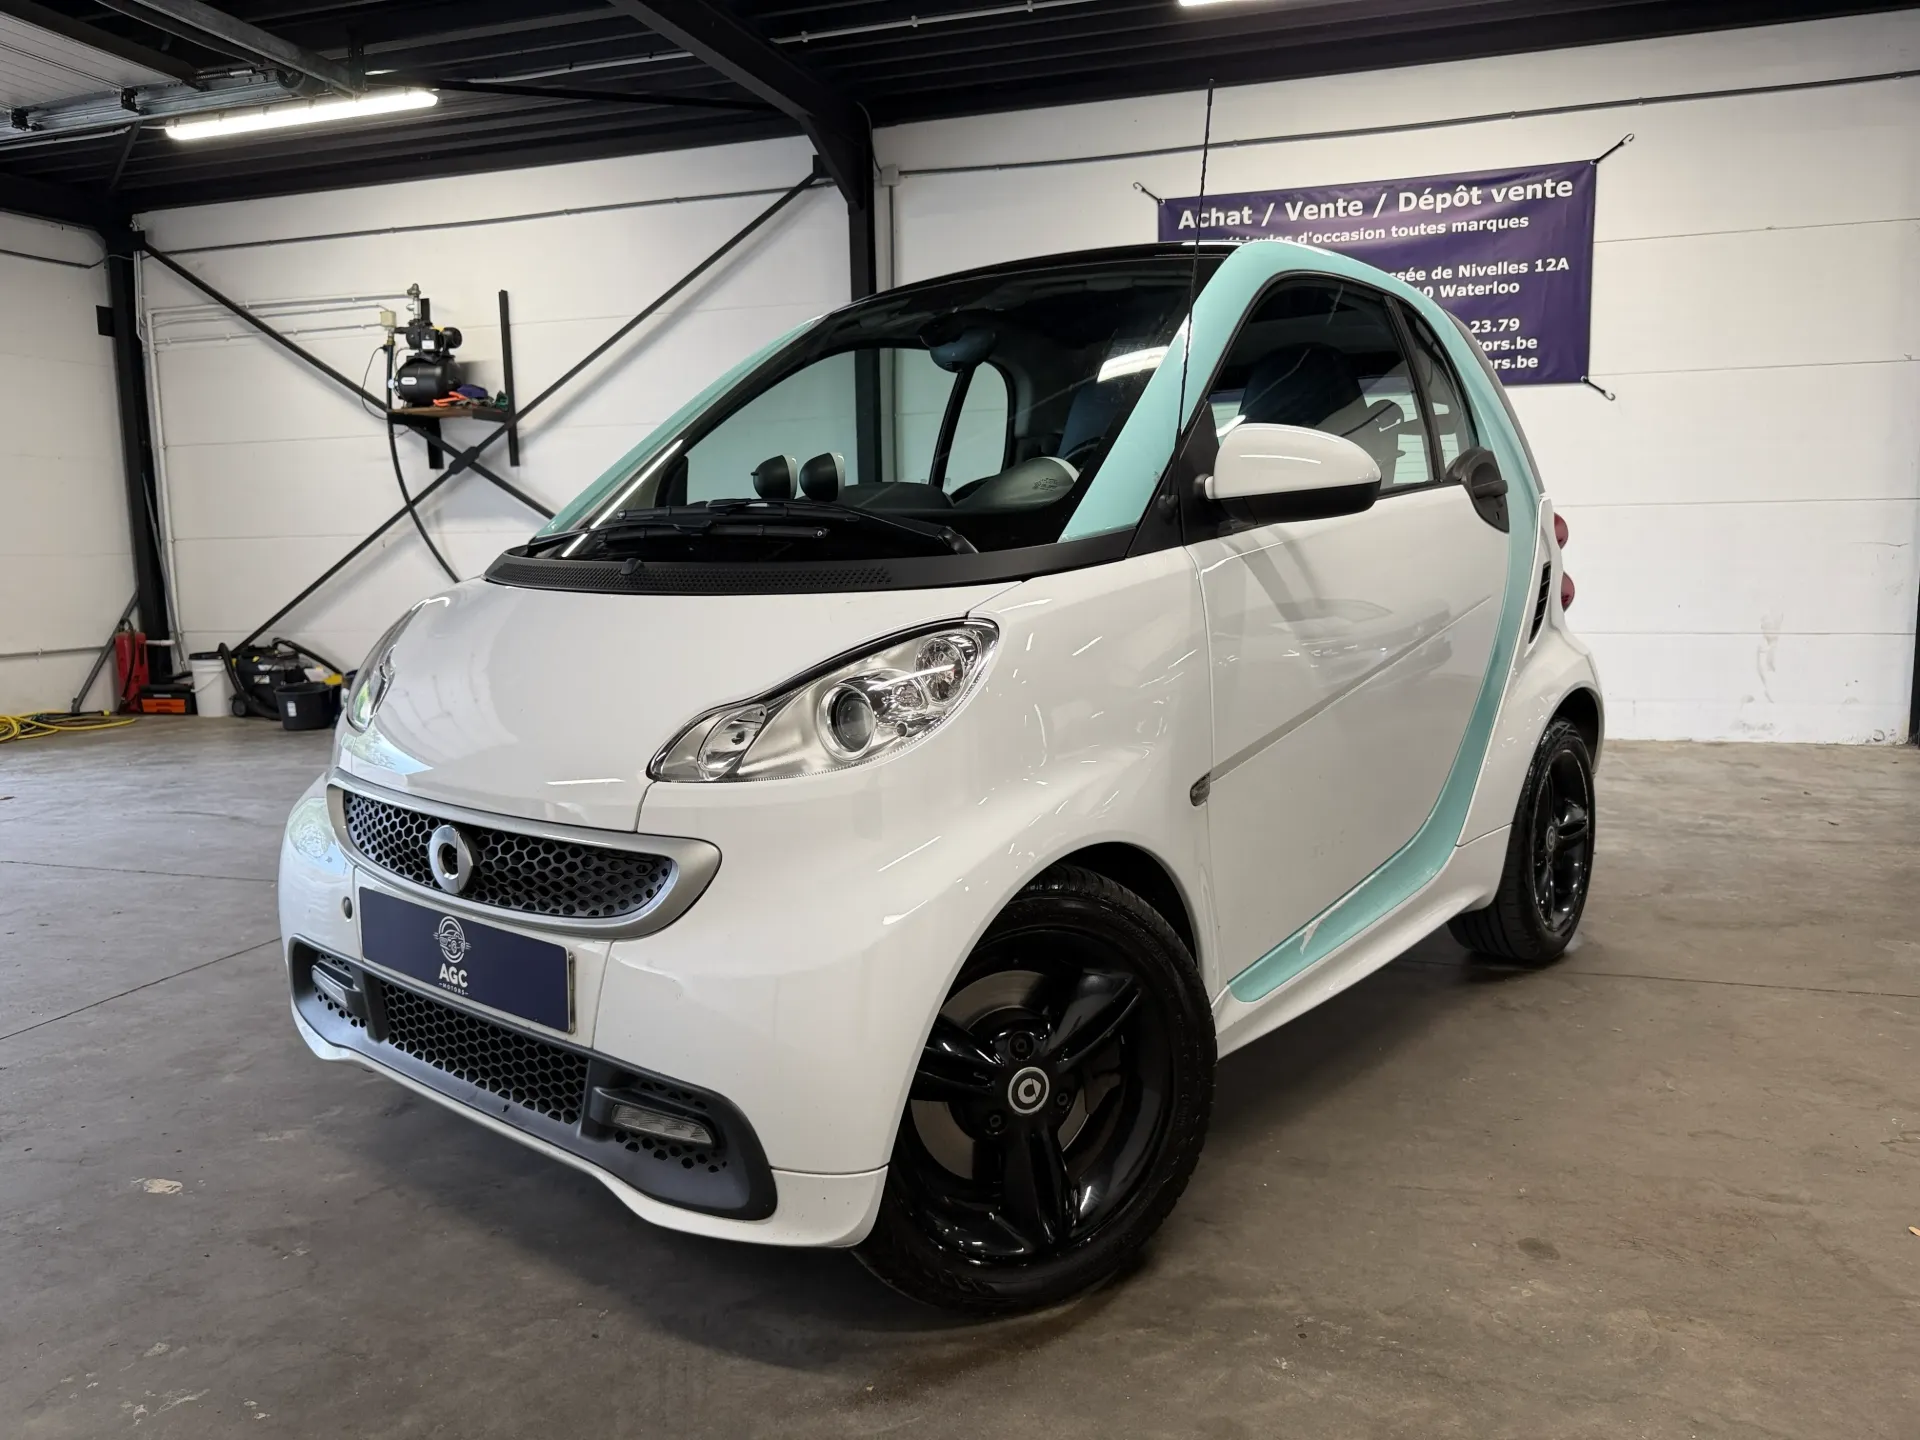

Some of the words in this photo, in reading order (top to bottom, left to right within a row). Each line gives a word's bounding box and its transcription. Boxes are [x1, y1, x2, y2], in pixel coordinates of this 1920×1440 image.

[1178, 206, 1252, 229] Achat
[1261, 203, 1275, 227] /
[1285, 198, 1363, 221] Vente
[1372, 193, 1387, 218] /
[1398, 185, 1482, 214] Dépôt
[1491, 178, 1573, 202] vente
[1297, 227, 1386, 244] d'occasion
[1391, 222, 1447, 238] toutes
[1451, 216, 1530, 233] marques
[1431, 265, 1453, 280] de
[1458, 261, 1529, 278] Nivelles
[1534, 257, 1570, 273] 12A
[1439, 281, 1520, 298] Waterloo
[1470, 317, 1520, 334] 23.79
[439, 962, 468, 988] AGC
